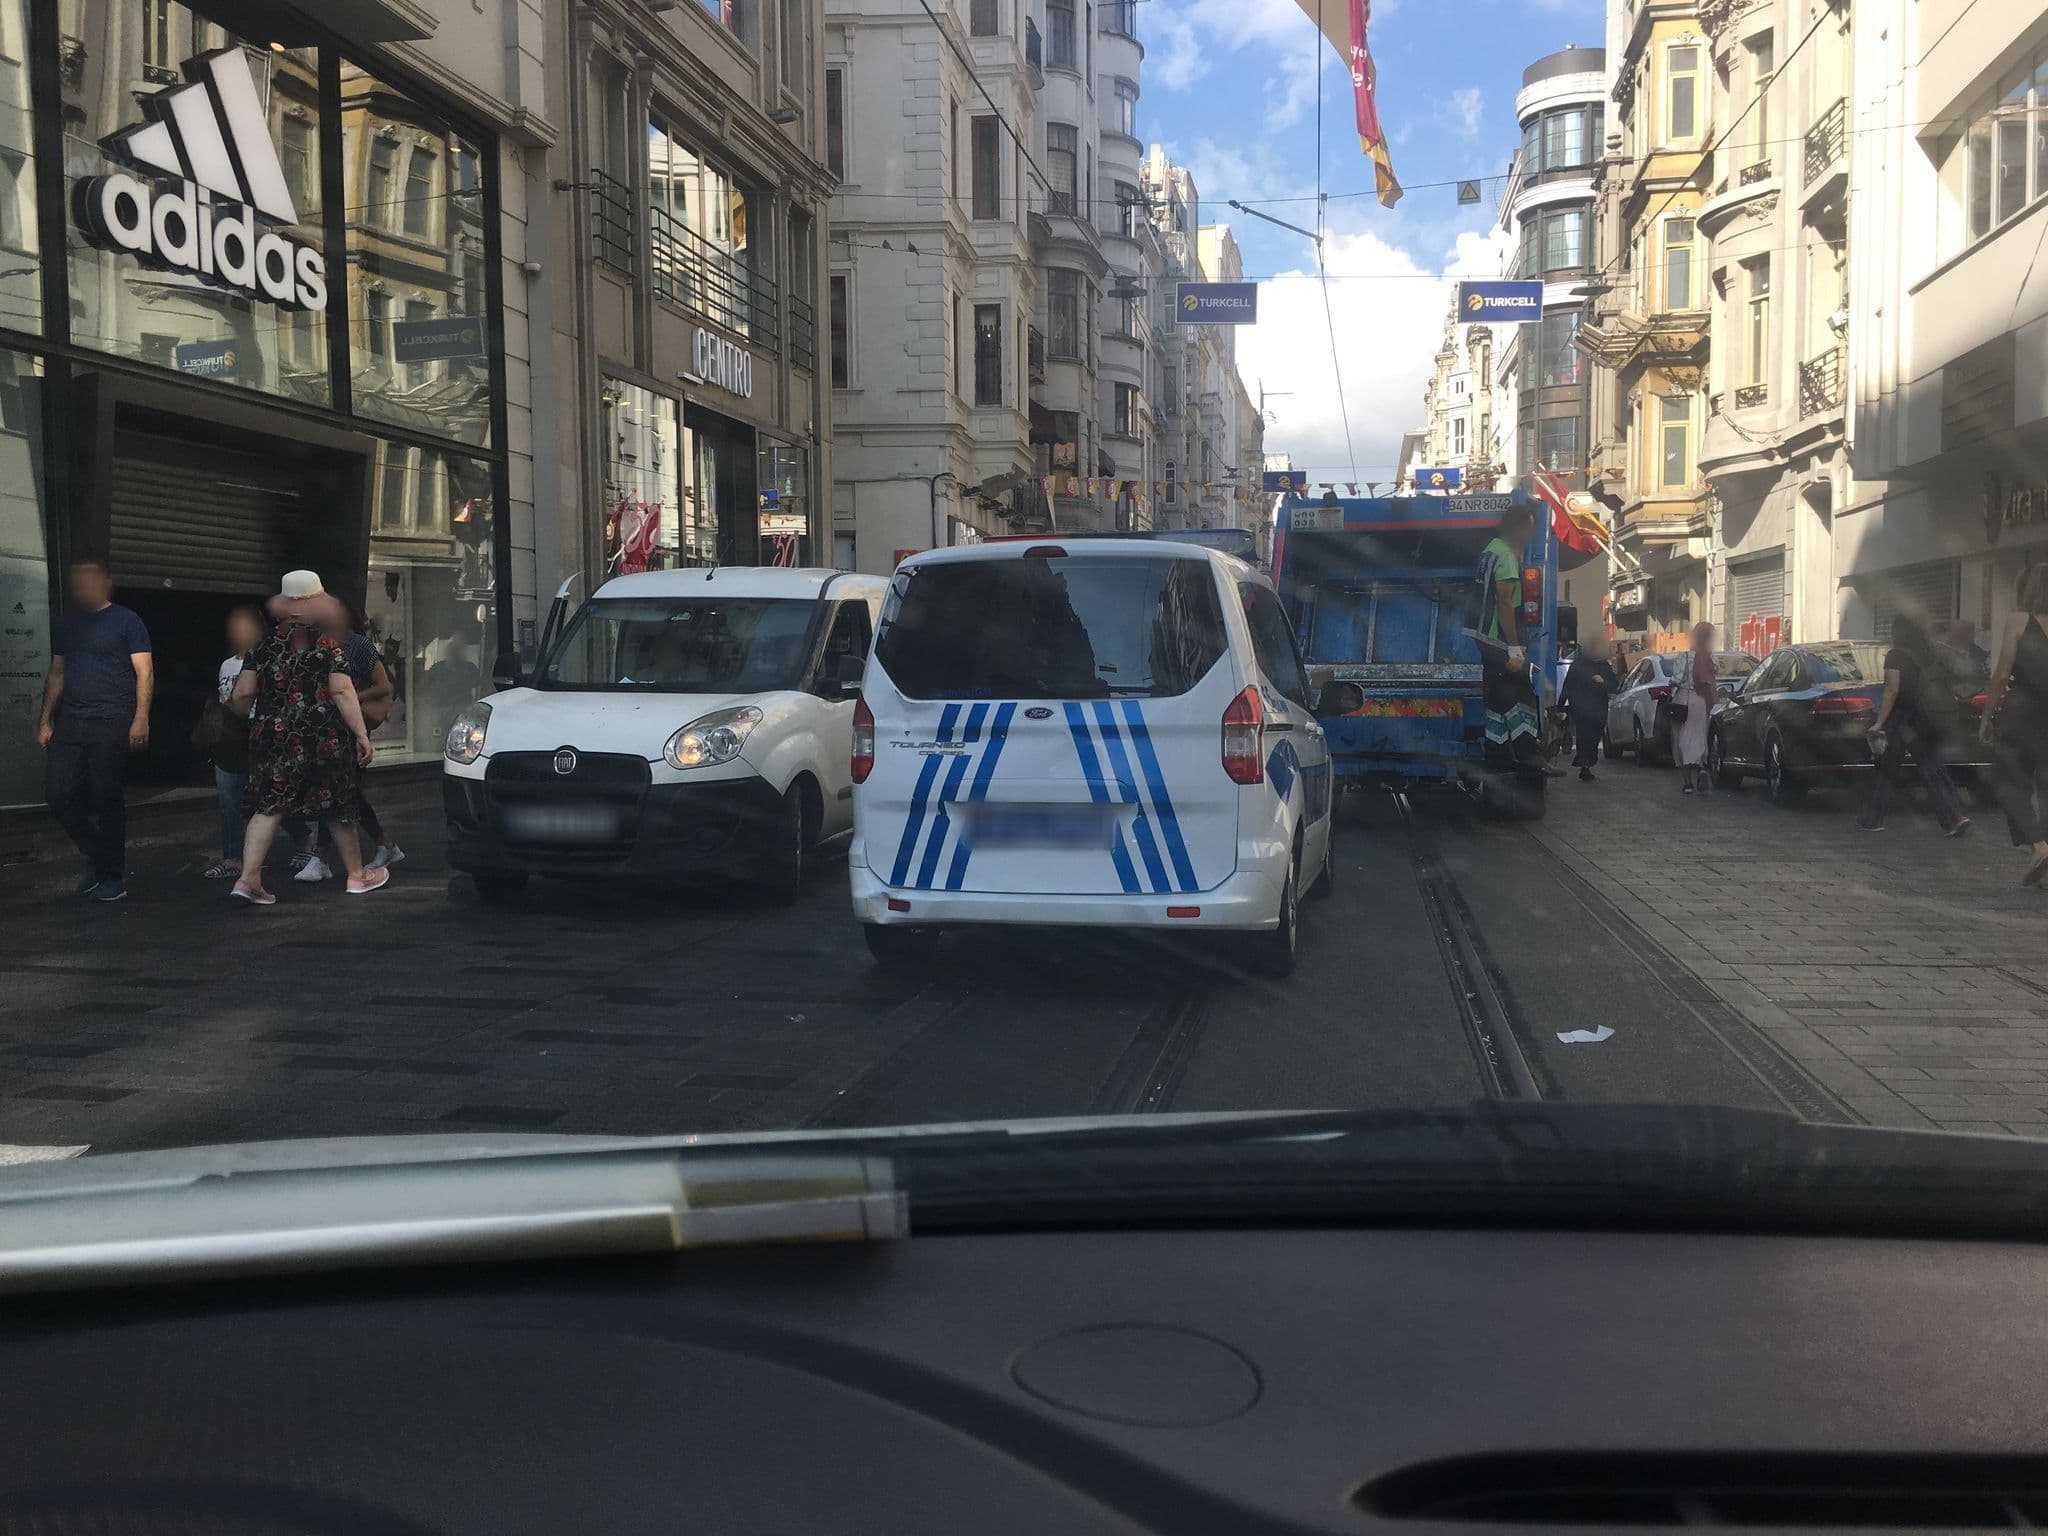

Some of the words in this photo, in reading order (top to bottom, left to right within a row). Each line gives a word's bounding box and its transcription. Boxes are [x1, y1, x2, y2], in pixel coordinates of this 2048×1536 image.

[102, 174, 327, 311] adidas
[1200, 298, 1251, 307] TURKCELL
[1483, 297, 1537, 307] TURKCELL
[695, 327, 752, 398] CENTRO
[1450, 500, 1463, 511] 34
[1465, 499, 1482, 511] NR
[889, 741, 966, 749] TOURNEO
[558, 756, 572, 769] FIAT
